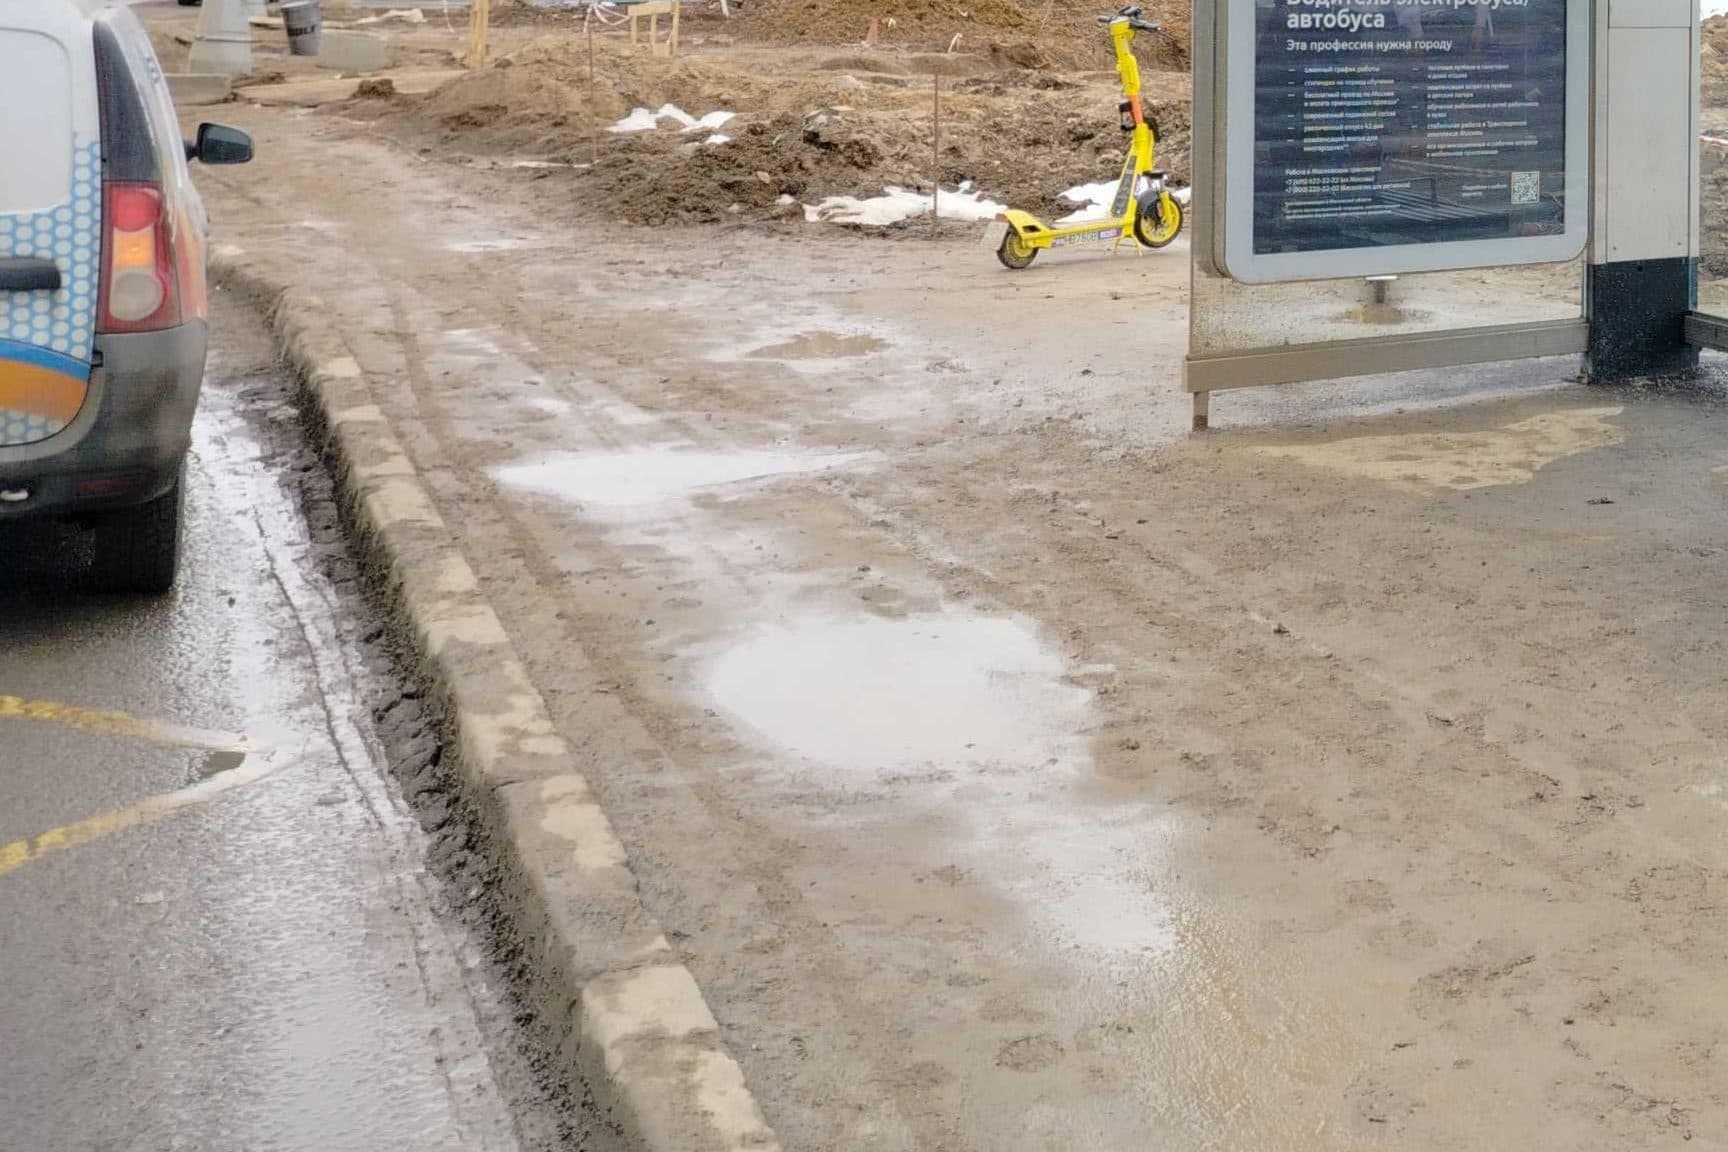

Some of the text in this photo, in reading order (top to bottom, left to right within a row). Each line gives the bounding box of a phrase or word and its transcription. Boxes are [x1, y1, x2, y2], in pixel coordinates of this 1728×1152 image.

[1287, 9, 1385, 32] автобуса
[1287, 39, 1453, 54] Эта профессия нужна городу
